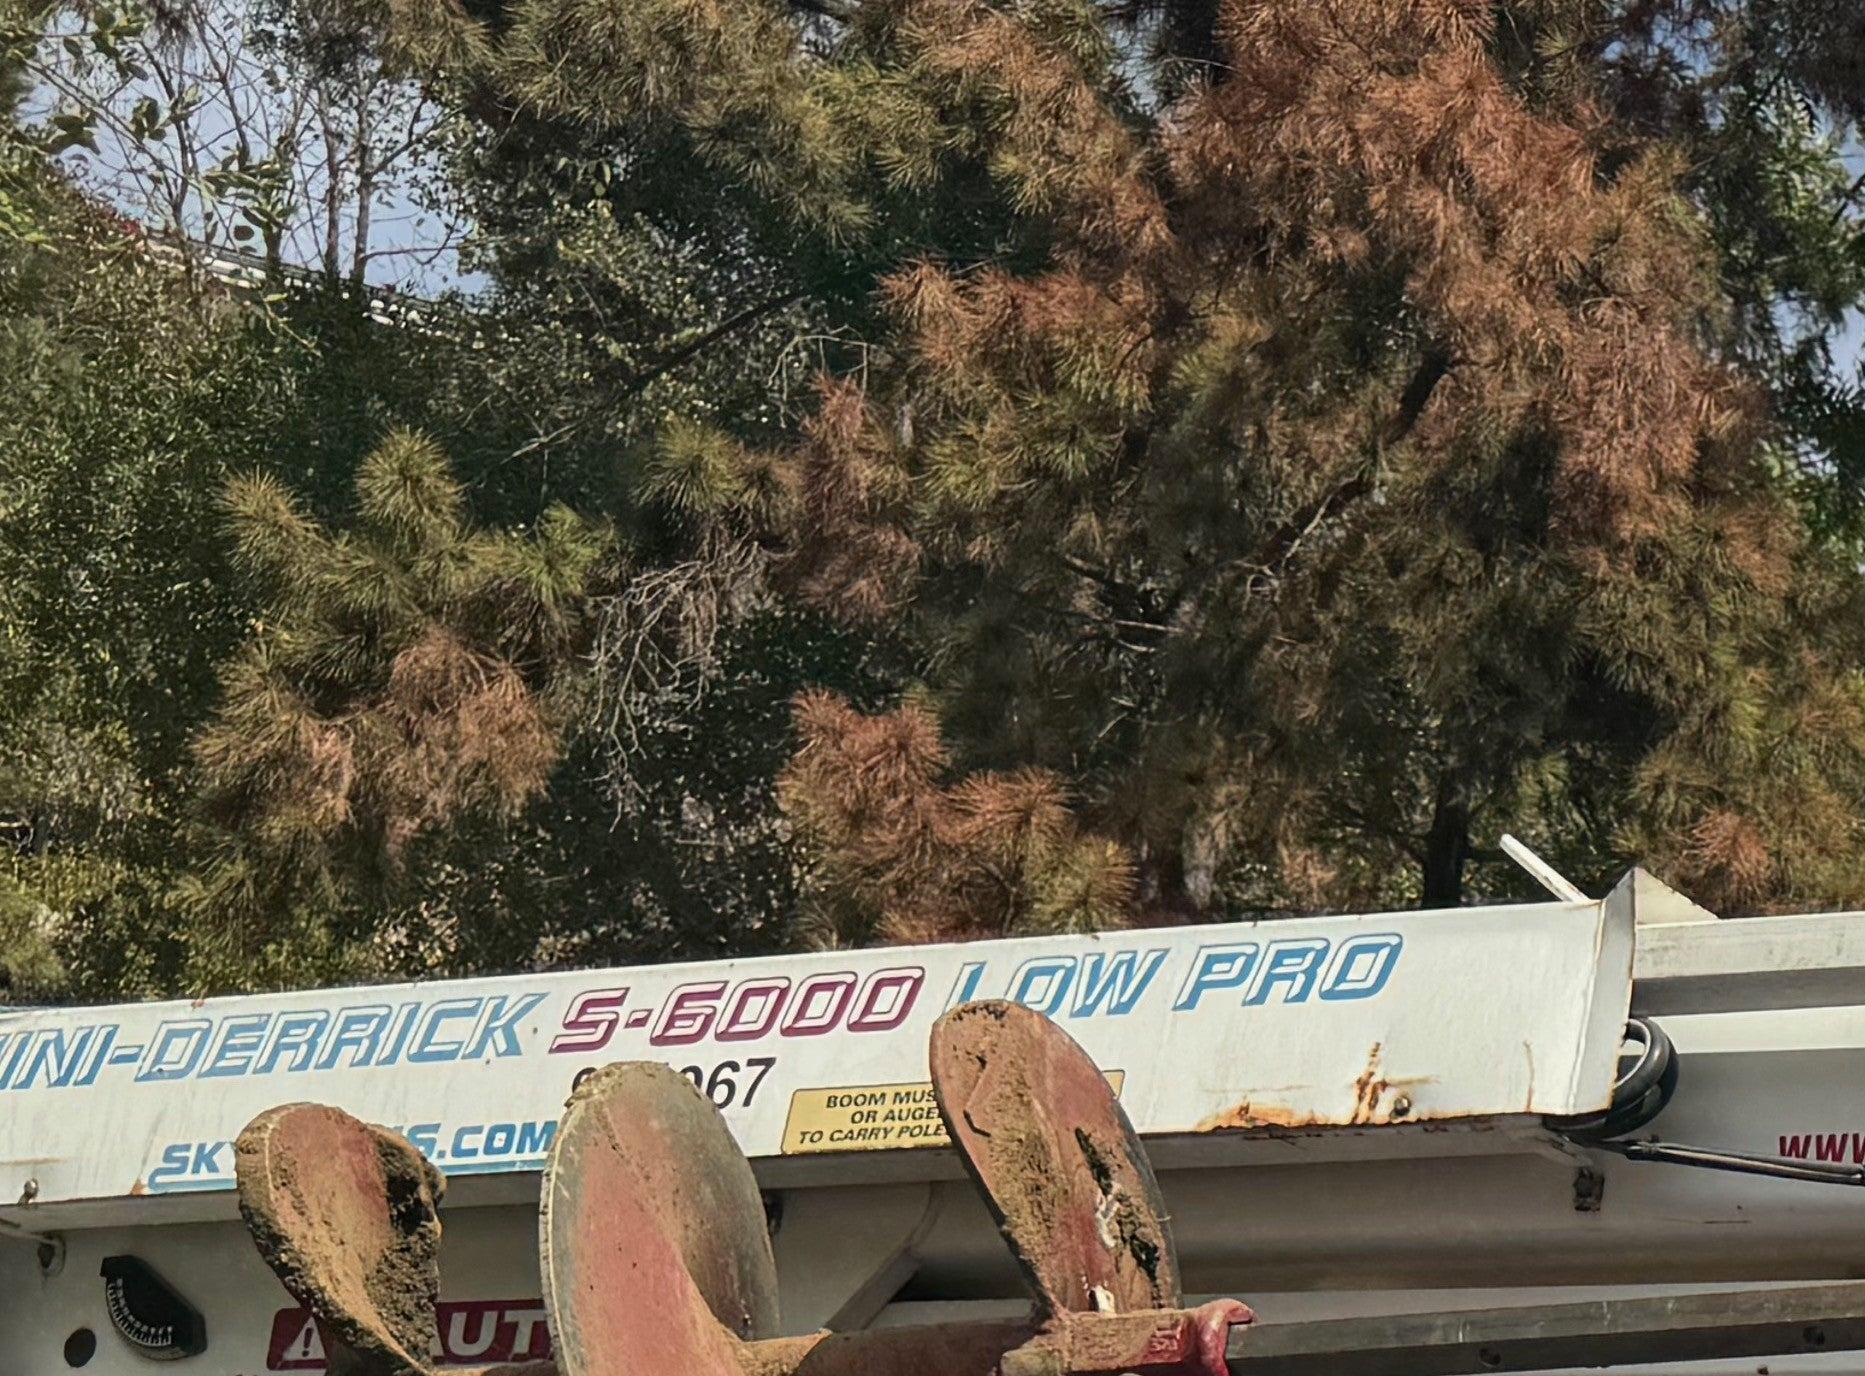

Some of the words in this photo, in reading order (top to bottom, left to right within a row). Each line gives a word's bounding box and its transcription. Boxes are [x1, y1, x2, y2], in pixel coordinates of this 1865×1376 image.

[0, 992, 551, 1090] INI-DERRICK
[548, 966, 925, 1054] S-6000
[943, 947, 1171, 1018] LOW
[1172, 933, 1404, 1011] PRO
[826, 1092, 887, 1109] BOOM
[892, 1089, 936, 1105] MUS
[850, 1110, 878, 1124] OR
[882, 1107, 940, 1123] AUGE
[799, 1130, 824, 1144] TO
[828, 1126, 895, 1142] CARRY
[896, 1123, 945, 1139] POLE
